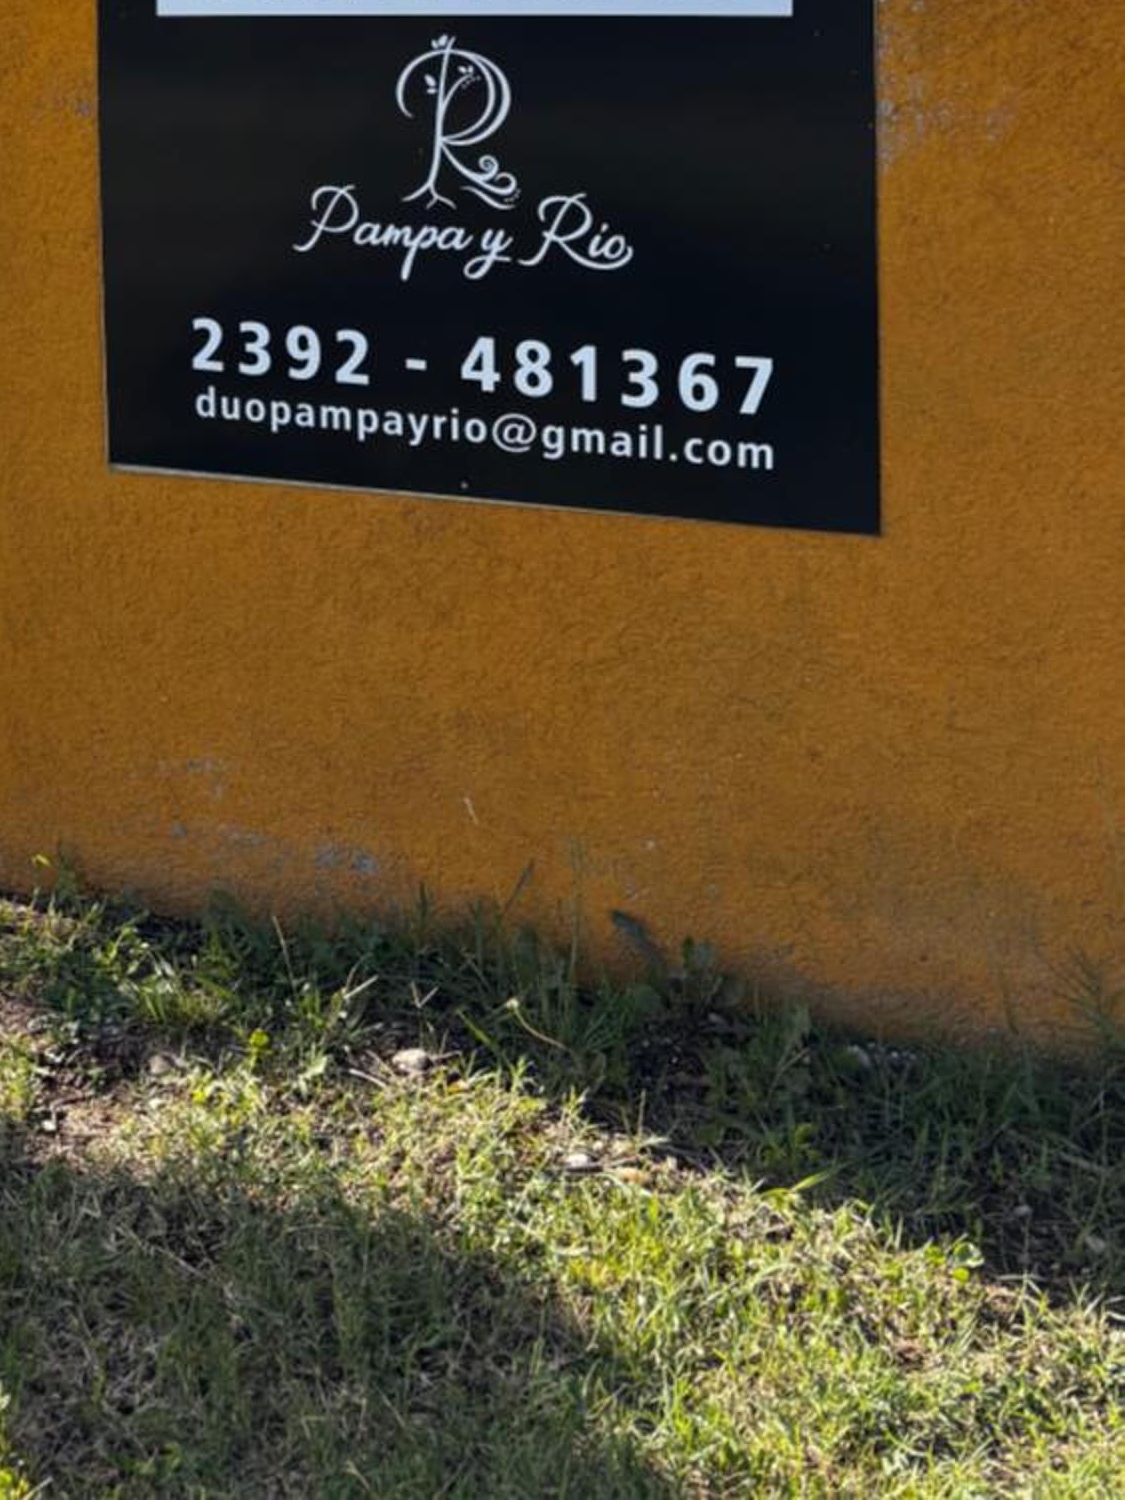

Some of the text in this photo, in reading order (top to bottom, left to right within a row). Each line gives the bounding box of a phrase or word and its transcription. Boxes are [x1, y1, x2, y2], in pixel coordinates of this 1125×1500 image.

[292, 184, 474, 282] Pampa
[462, 228, 513, 280] y
[191, 316, 774, 416] 2392 - 481367
[195, 384, 774, 471] duopampayrio@gmail.com
